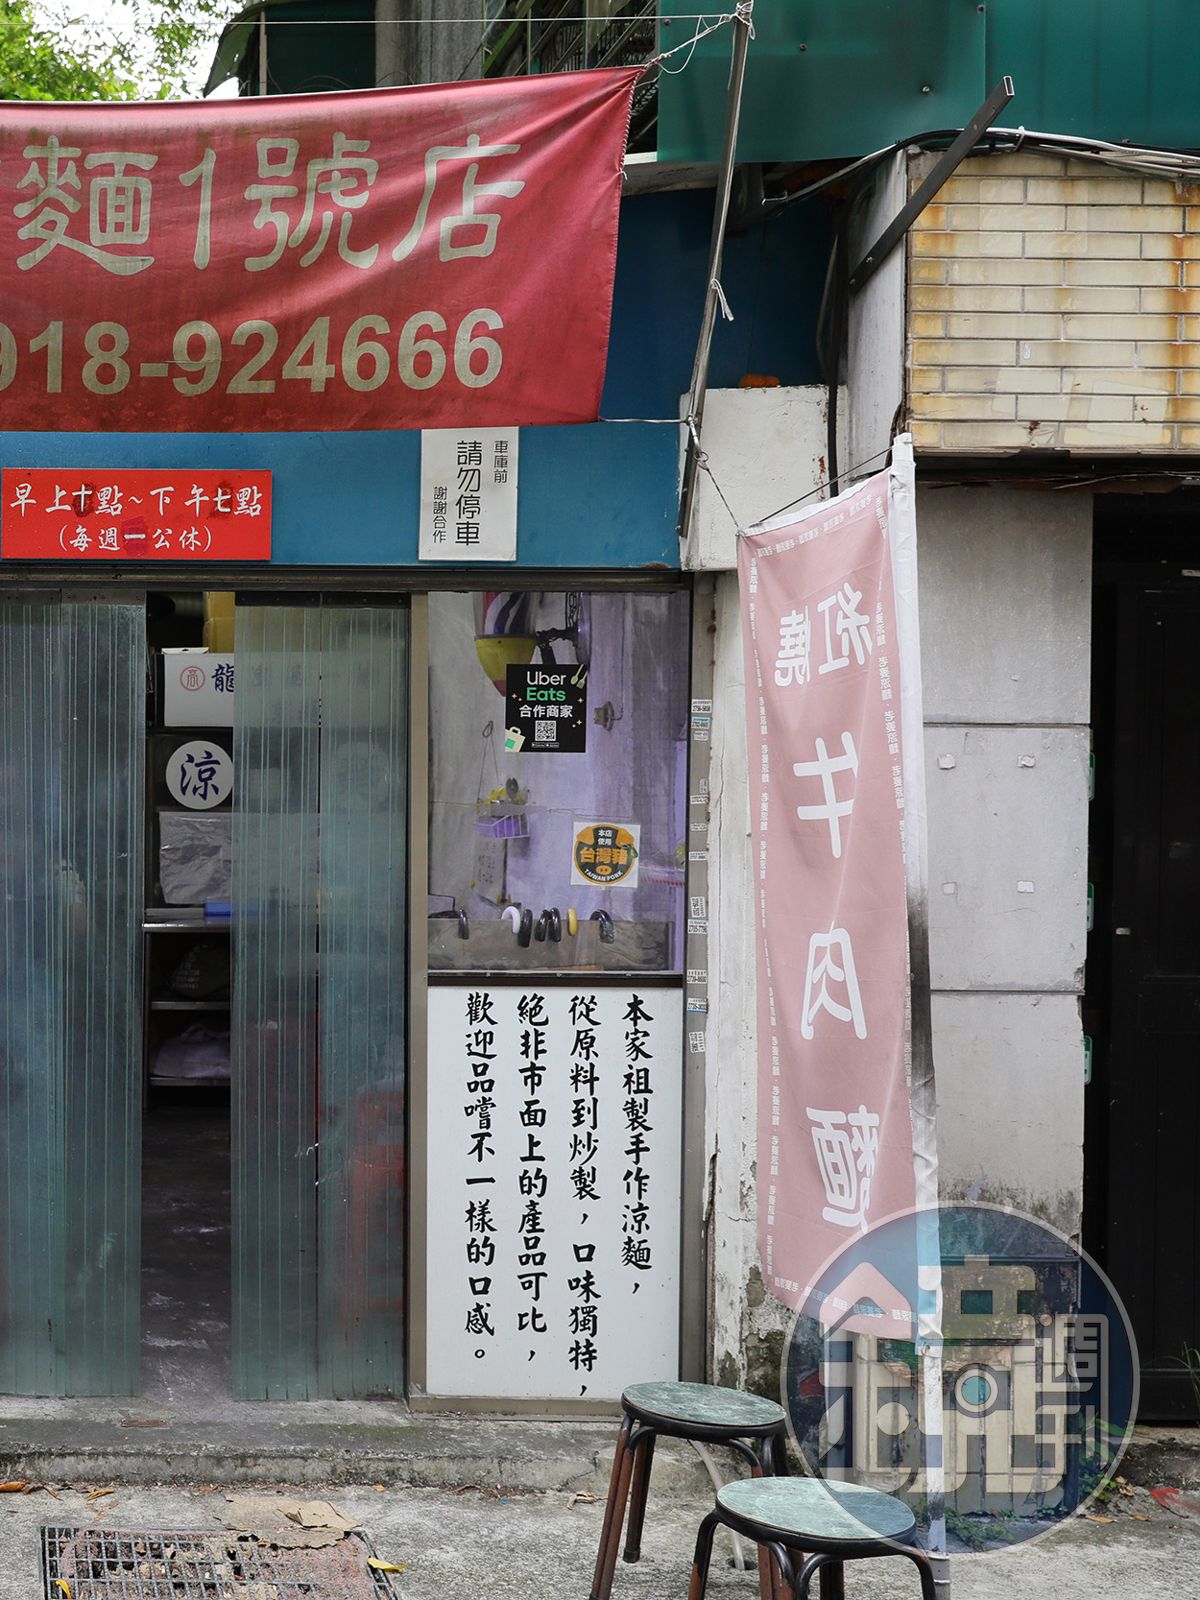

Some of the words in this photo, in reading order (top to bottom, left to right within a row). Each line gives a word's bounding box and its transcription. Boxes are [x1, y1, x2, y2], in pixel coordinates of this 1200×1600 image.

[494, 440, 508, 483] 車庫前
[455, 440, 482, 546] 請勿停車
[432, 486, 447, 543] 謝謝合作
[527, 671, 566, 685] Uber
[527, 687, 566, 701] Eats
[519, 705, 573, 718] 合作商家
[180, 750, 221, 800] 涼
[584, 868, 606, 881] TAIWAN
[607, 870, 623, 881] PORK
